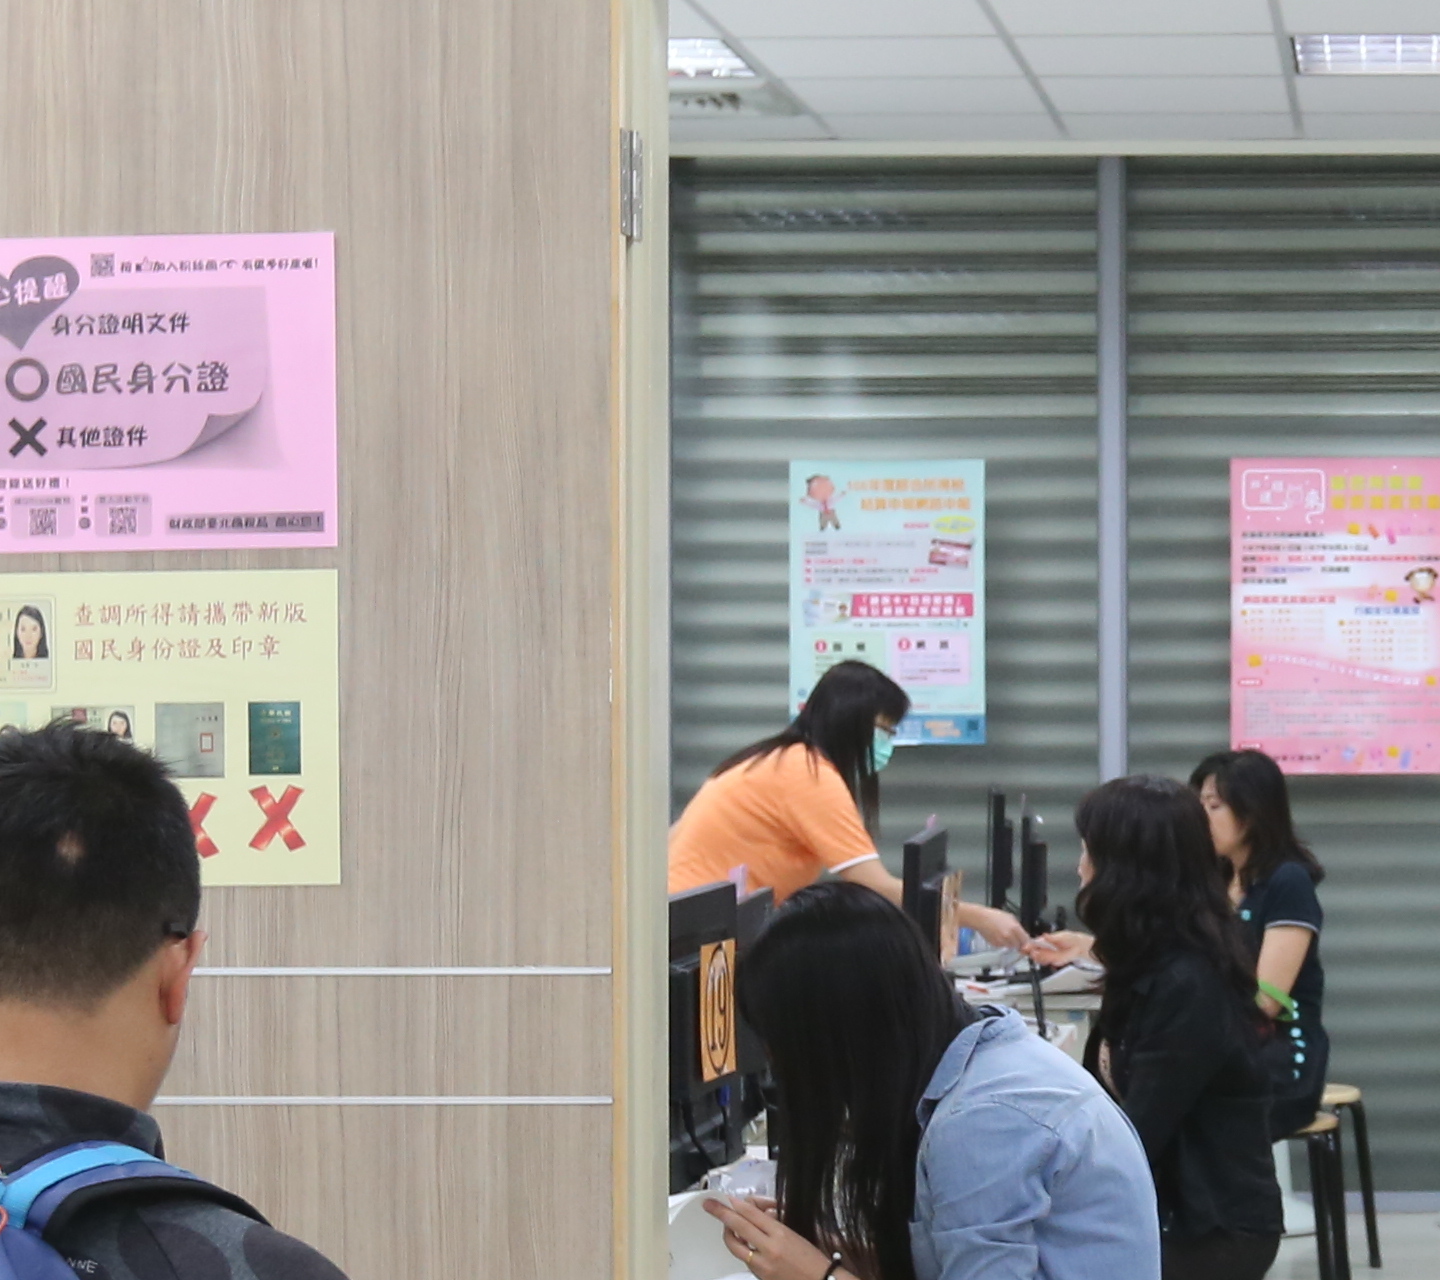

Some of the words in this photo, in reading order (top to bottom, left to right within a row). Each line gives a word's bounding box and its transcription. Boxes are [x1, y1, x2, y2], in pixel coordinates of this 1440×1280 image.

[51, 312, 191, 337] 身分證明文件
[56, 361, 230, 394] 國民身分證
[56, 425, 148, 448] 其他證件
[73, 601, 308, 628] 查調所得請攜帶新版
[73, 634, 281, 662] 國民身份證及印章
[711, 966, 726, 1051] 19
